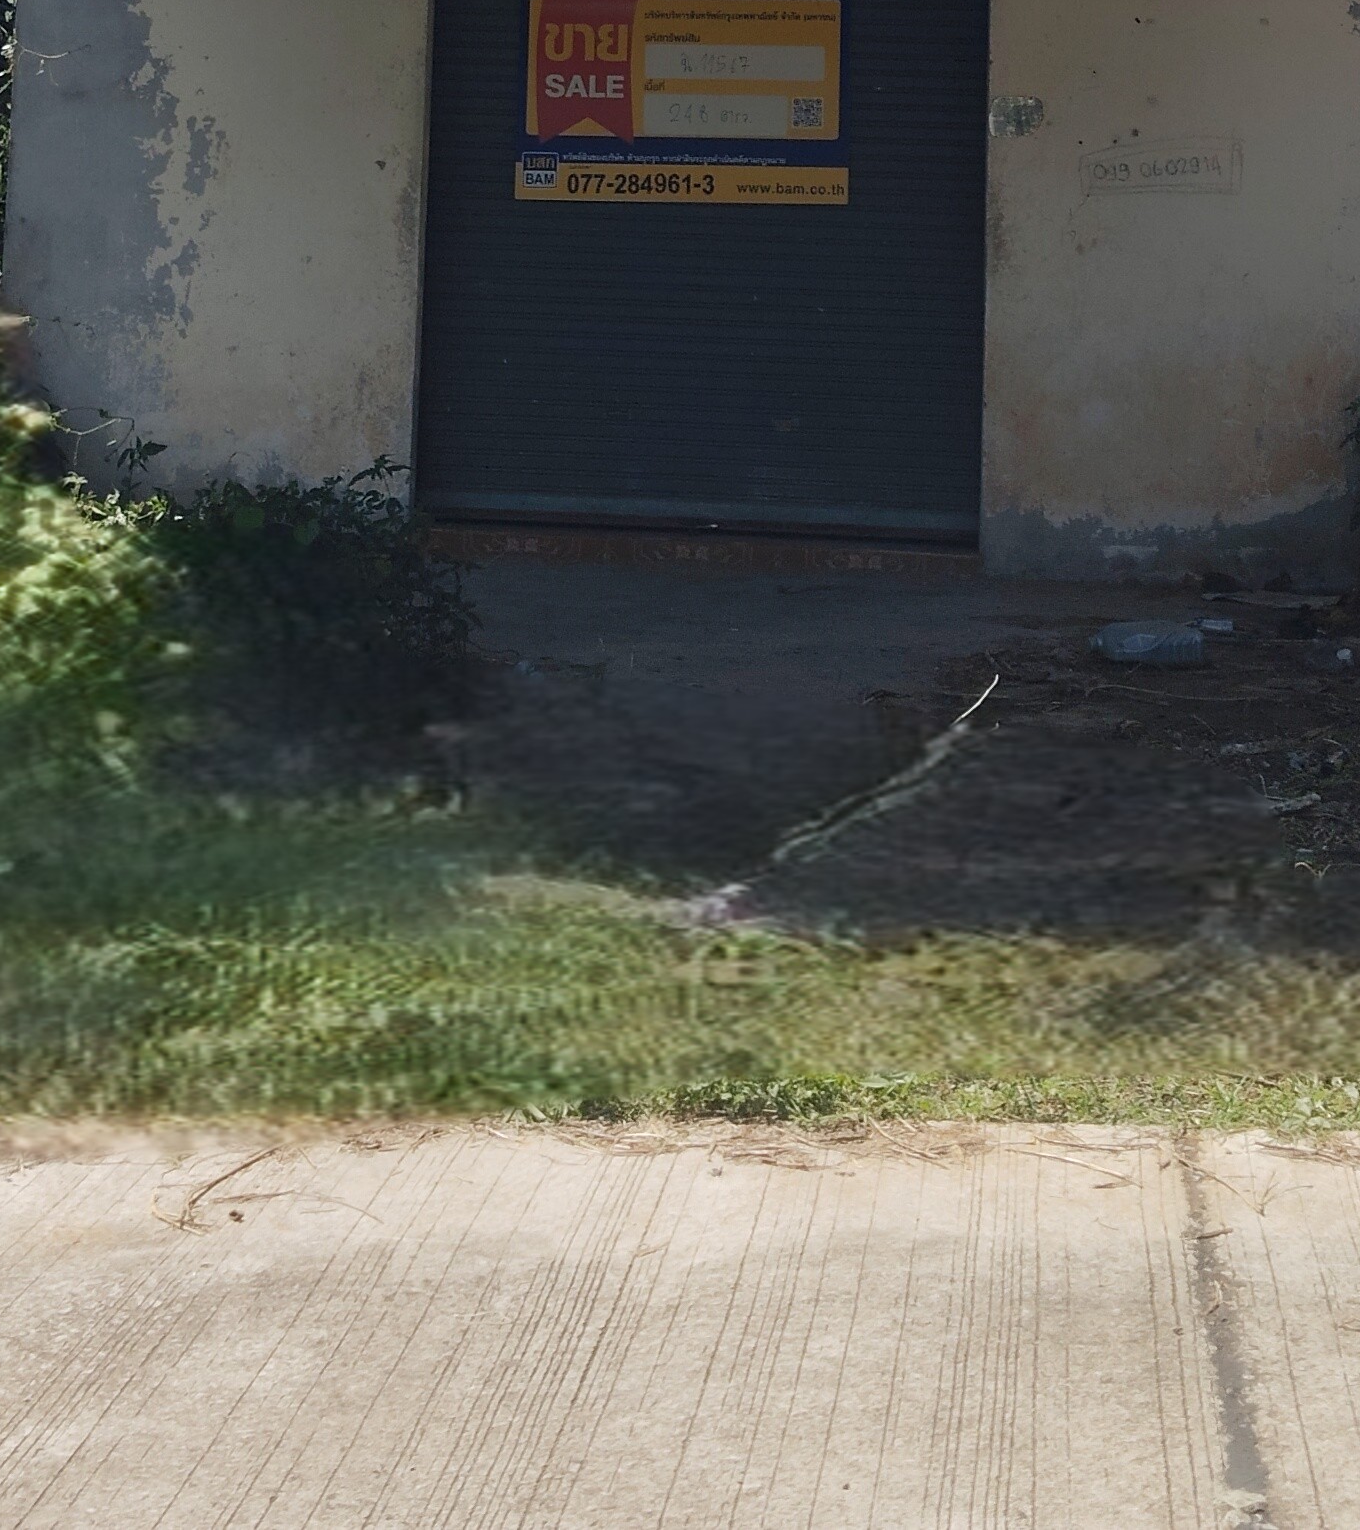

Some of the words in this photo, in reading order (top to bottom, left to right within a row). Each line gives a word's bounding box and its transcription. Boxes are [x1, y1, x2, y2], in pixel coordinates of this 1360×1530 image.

[544, 22, 629, 62] ขาย
[544, 73, 625, 99] SALE
[525, 156, 556, 171] บสก
[525, 172, 555, 186] BAM
[567, 173, 715, 196] 077-284961-3
[736, 181, 845, 196] www.bam.co.th
